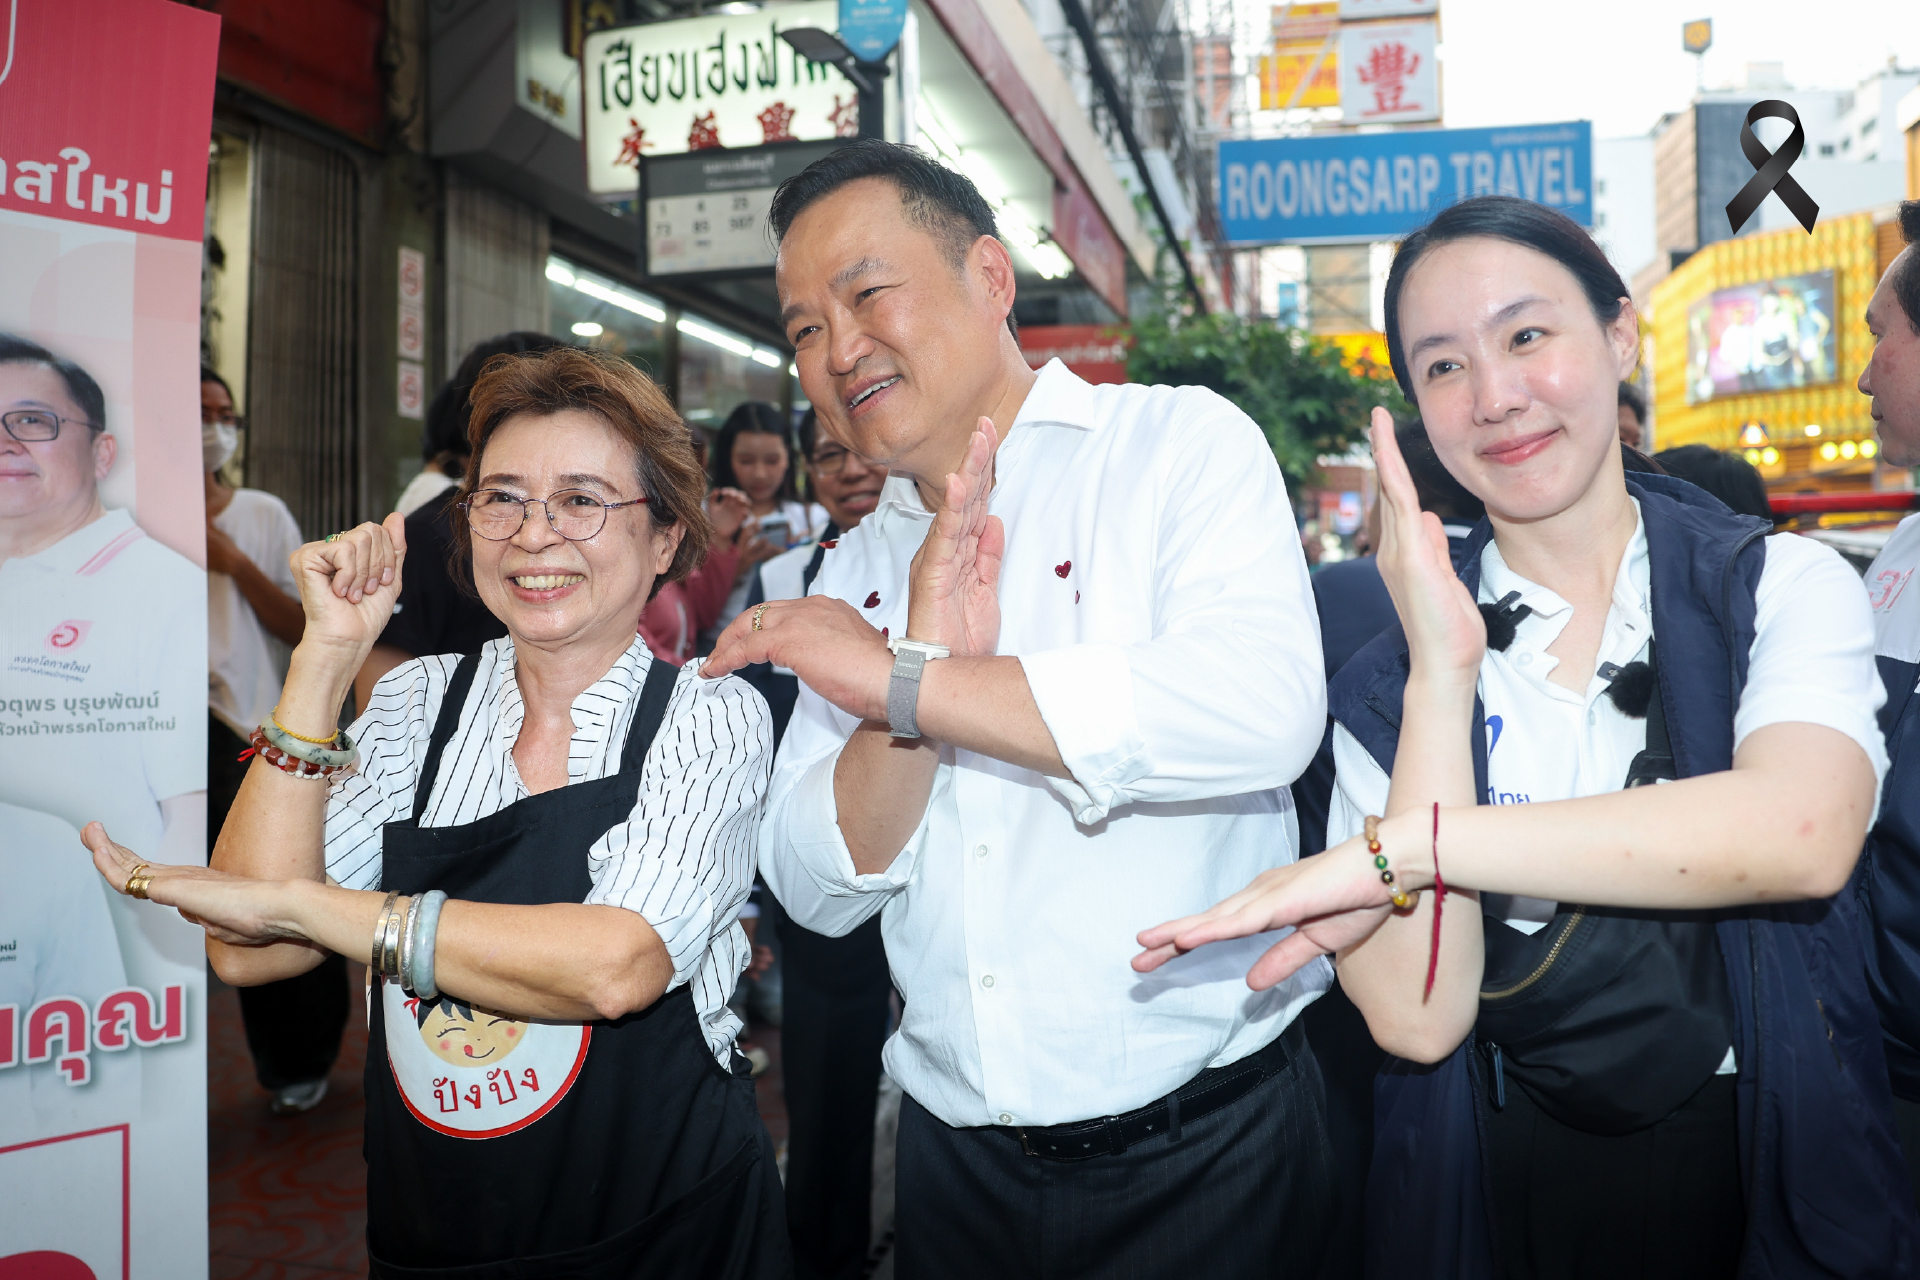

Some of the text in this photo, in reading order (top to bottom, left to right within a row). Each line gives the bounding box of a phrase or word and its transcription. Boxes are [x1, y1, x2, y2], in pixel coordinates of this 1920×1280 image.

[1227, 148, 1585, 221] ROONGSARP TRAVEL
[64, 691, 160, 716] บุรุษพัฒน์
[0, 985, 184, 1083] คุณ
[432, 1066, 540, 1113] ปังปัง
